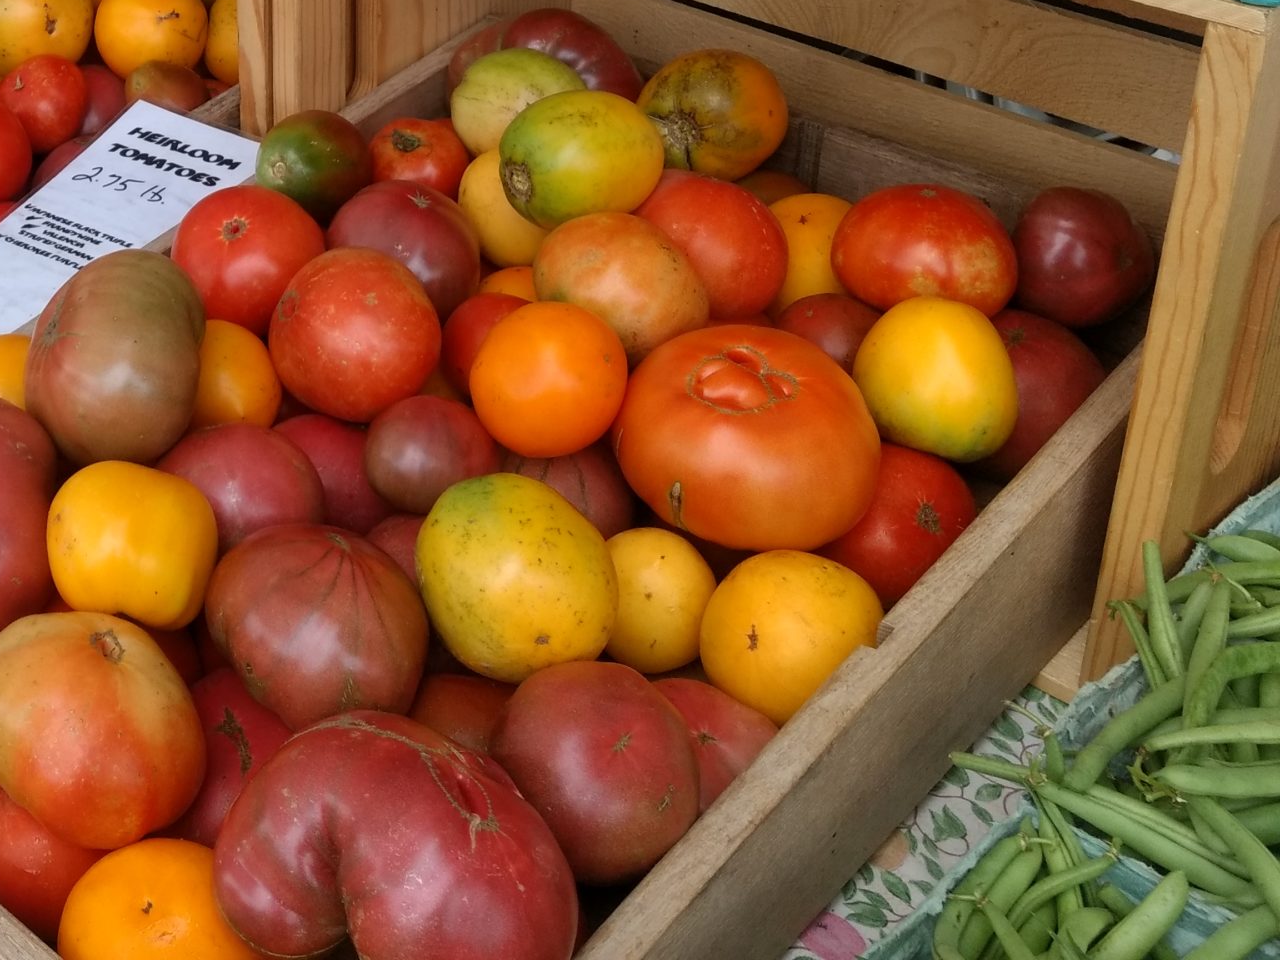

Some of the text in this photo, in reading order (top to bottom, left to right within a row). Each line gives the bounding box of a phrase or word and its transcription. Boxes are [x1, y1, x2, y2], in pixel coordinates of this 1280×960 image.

[127, 127, 242, 171] HEIRLOOM
[71, 166, 145, 191] 2.75
[107, 143, 222, 187] TOMATOES
[31, 205, 74, 226] JAPANESE
[72, 222, 102, 238] BLACK
[41, 220, 103, 246] BRANDYWINE
[4, 235, 53, 257] CHEROKEE
[18, 229, 95, 261] STRIPED GERMAN
[42, 229, 86, 249] VALENCIA
